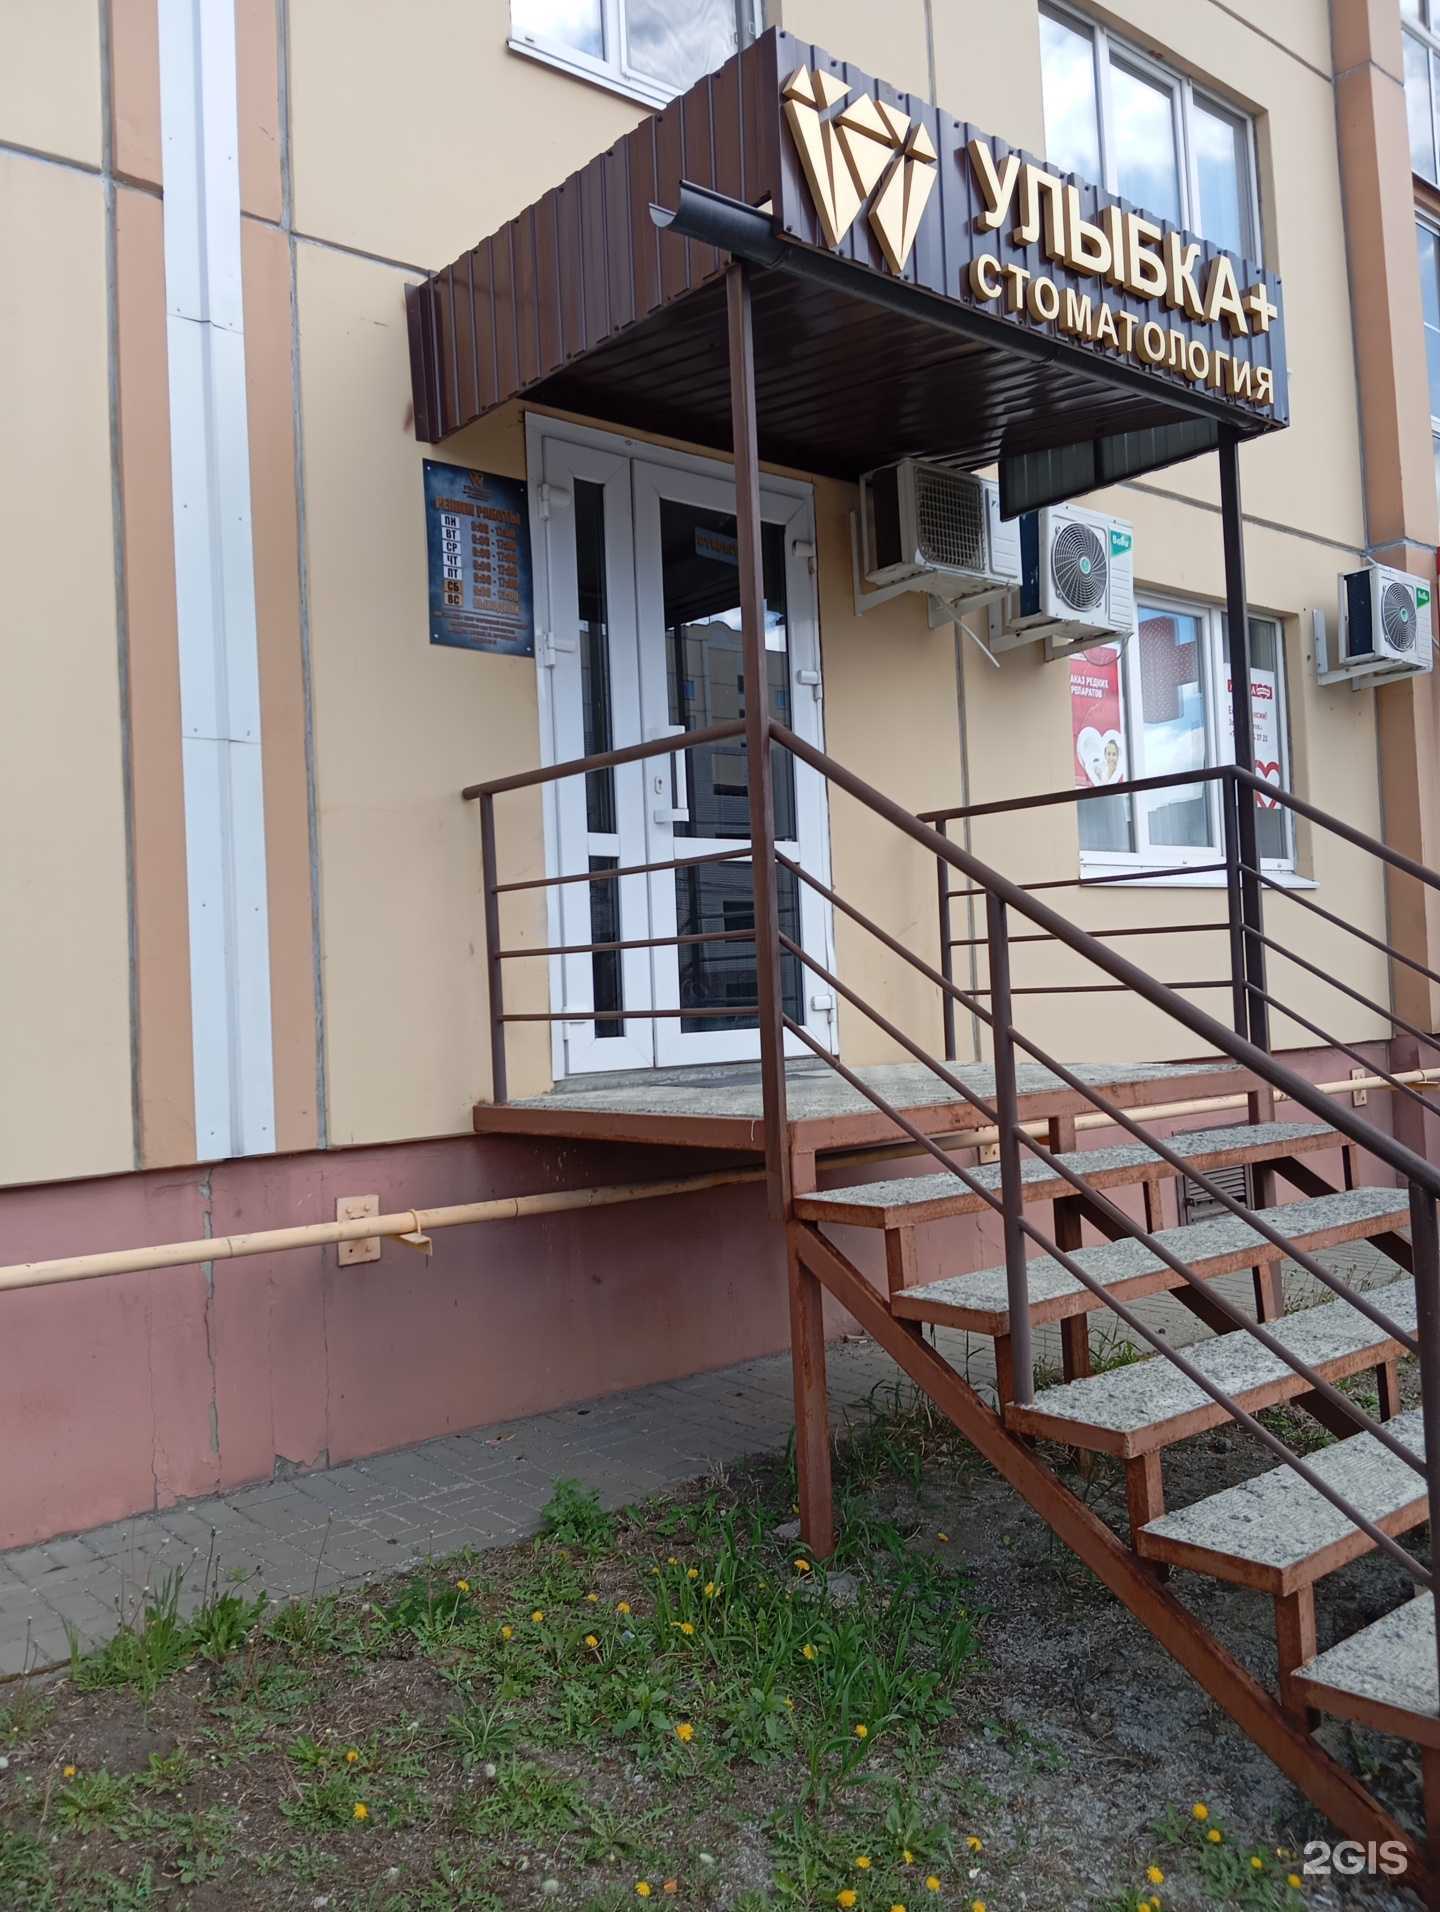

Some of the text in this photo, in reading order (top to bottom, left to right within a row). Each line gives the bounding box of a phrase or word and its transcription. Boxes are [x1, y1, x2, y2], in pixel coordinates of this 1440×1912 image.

[967, 138, 1278, 337] УЛЫБКА+
[969, 254, 1275, 406] СТОМАТОЛОГИЯ
[444, 515, 457, 526] ПН
[445, 529, 457, 540] ВТ
[446, 541, 458, 553] СР
[447, 555, 458, 566] ЧТ
[447, 568, 458, 579] ПТ
[447, 581, 459, 592] СБ
[448, 594, 460, 605] ВС
[1070, 673, 1086, 687] АКАЗ
[1070, 685, 1104, 699] РЕПАРАТОВ
